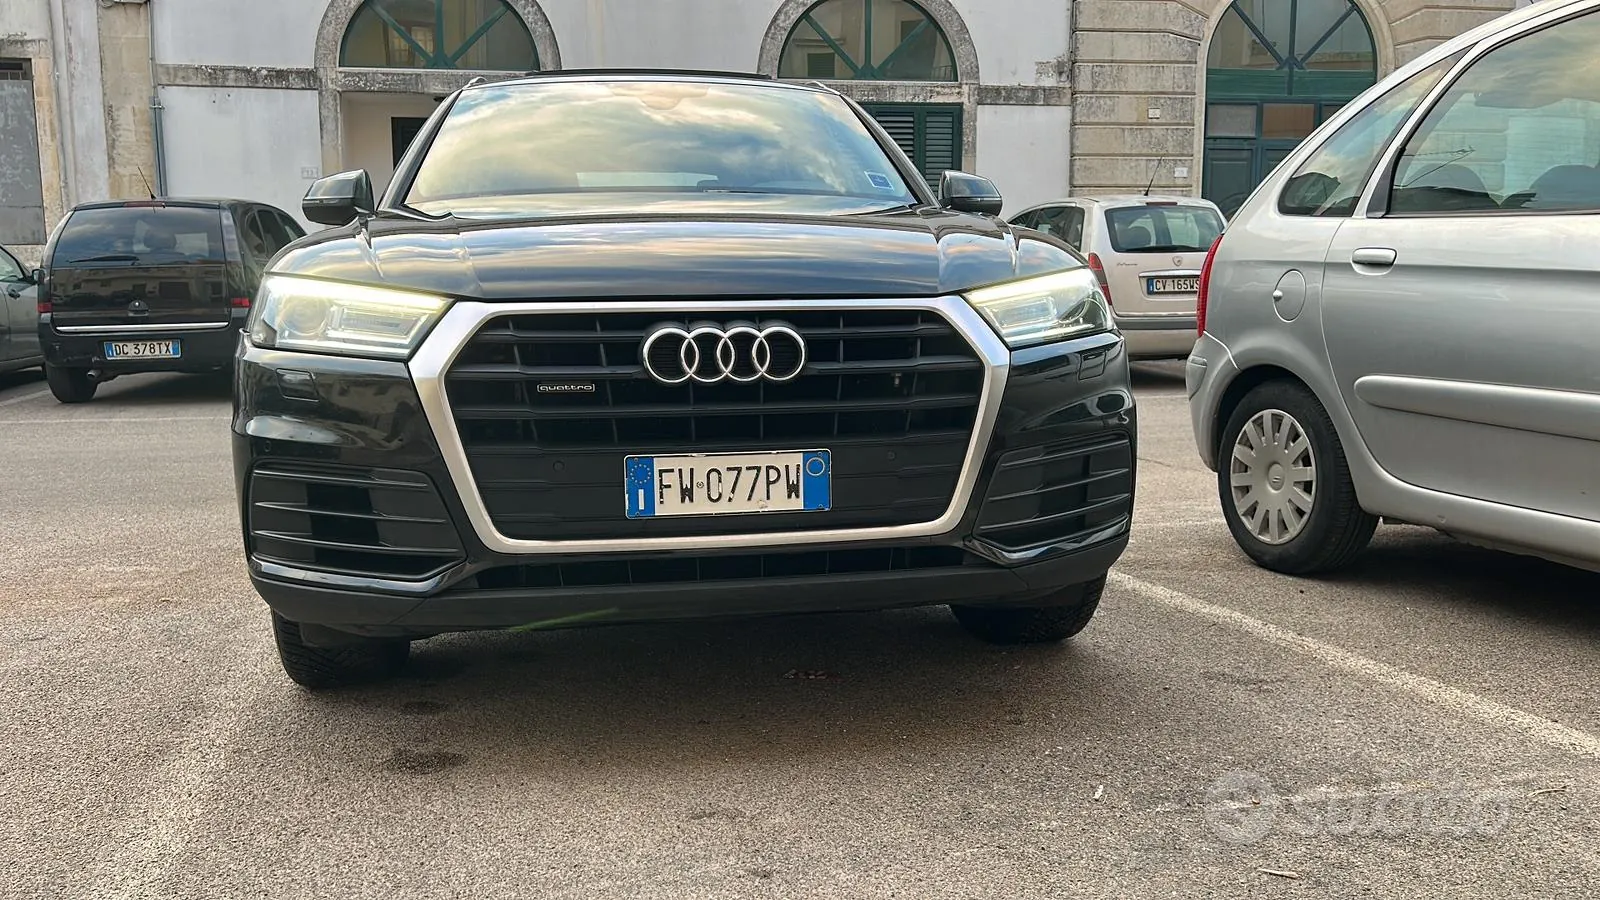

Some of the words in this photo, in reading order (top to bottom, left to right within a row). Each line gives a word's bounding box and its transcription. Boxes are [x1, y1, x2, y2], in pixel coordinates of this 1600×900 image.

[1155, 280, 1167, 290] CV
[115, 344, 128, 355] DC
[133, 343, 171, 354] 378TX
[658, 467, 694, 504] FW
[706, 464, 800, 503] 077PW
